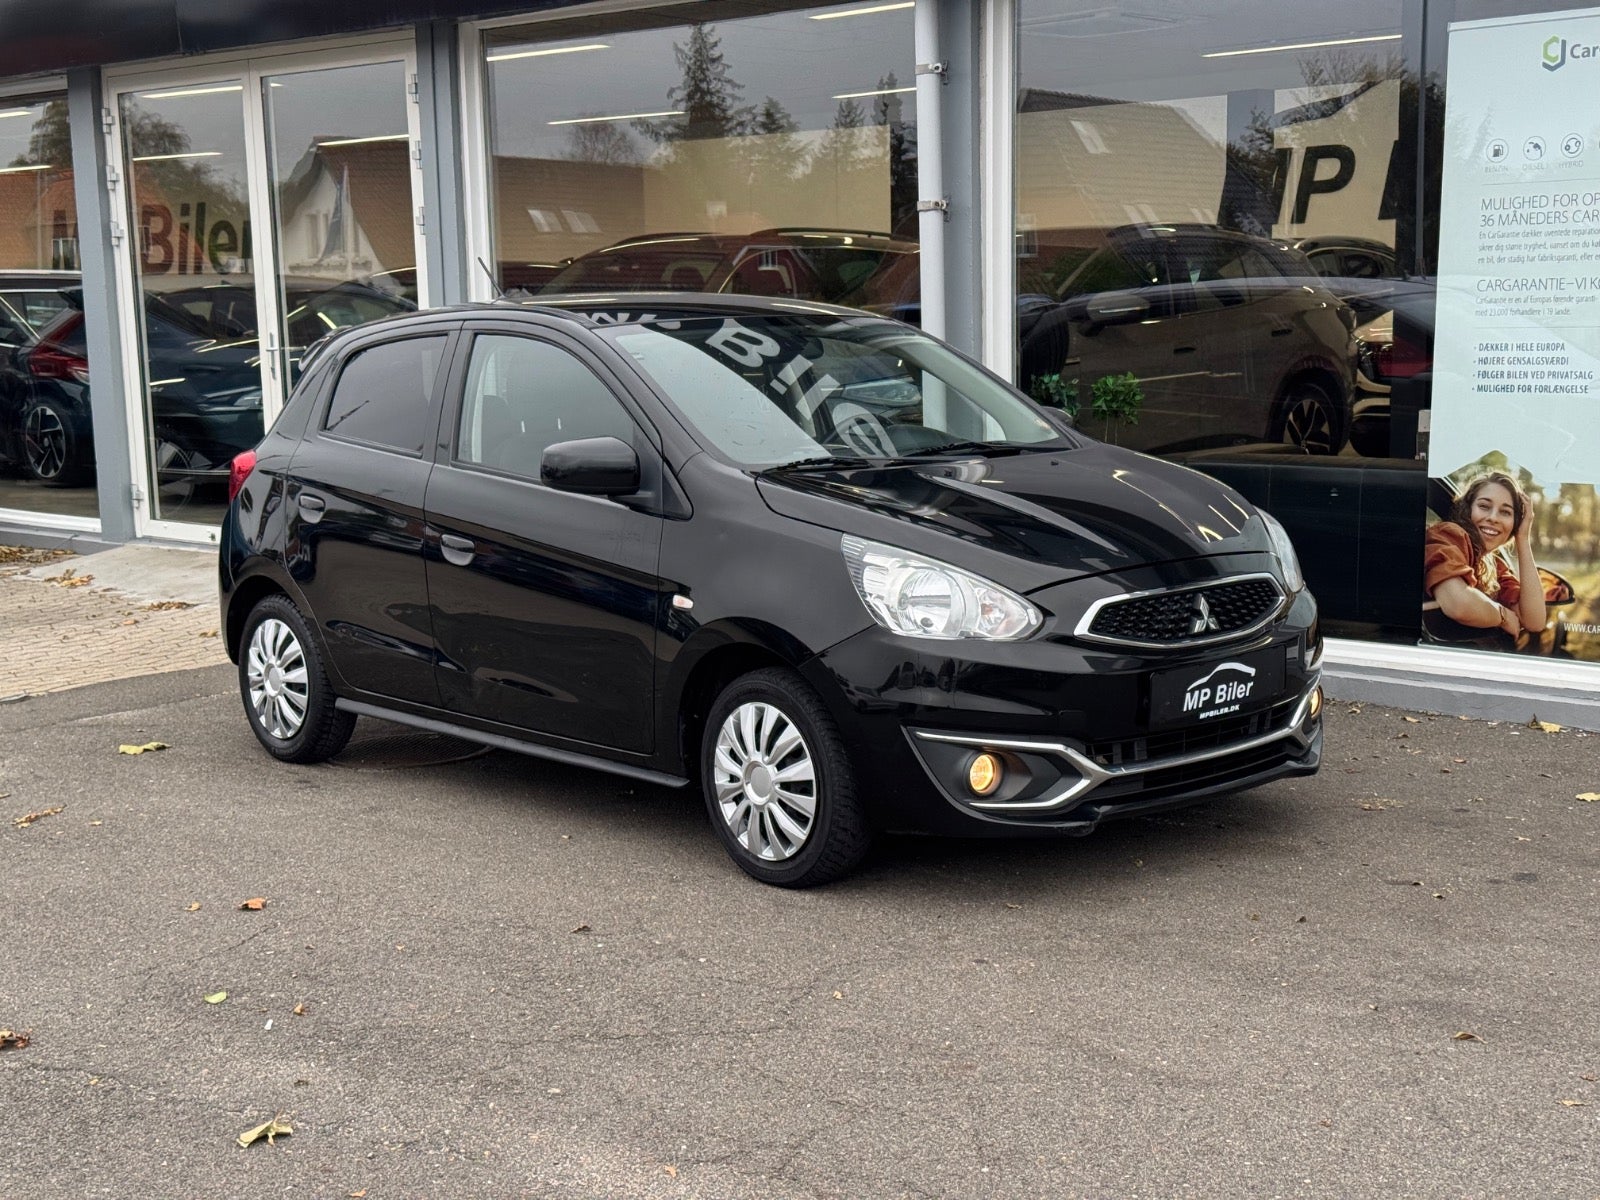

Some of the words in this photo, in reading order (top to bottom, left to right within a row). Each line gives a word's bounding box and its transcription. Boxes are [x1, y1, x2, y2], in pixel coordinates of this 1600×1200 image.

[1570, 43, 1600, 59] Car
[1481, 195, 1549, 210] MULIGHED
[1553, 194, 1579, 207] FOR
[1479, 213, 1495, 228] 36
[1498, 209, 1569, 226] MÅNEDERS
[1478, 342, 1509, 352] DÆKKER
[1515, 342, 1534, 352] HELE
[1536, 342, 1565, 352] EUROPA
[1478, 356, 1505, 366] HØJERE
[1507, 356, 1569, 366] GENSALGSVÆRDI
[1477, 370, 1505, 380] FØLGER
[1506, 370, 1529, 380] BILEN
[1530, 370, 1545, 380] VED
[1547, 370, 1594, 380] PRIVATSALG
[1476, 384, 1515, 393] MULIGHED
[1517, 384, 1532, 393] FOR
[1534, 384, 1589, 394] FORLÆNGELSE
[1183, 688, 1211, 711] MP
[1215, 681, 1254, 704] Biler
[1199, 705, 1240, 719] MPBILER.DK
